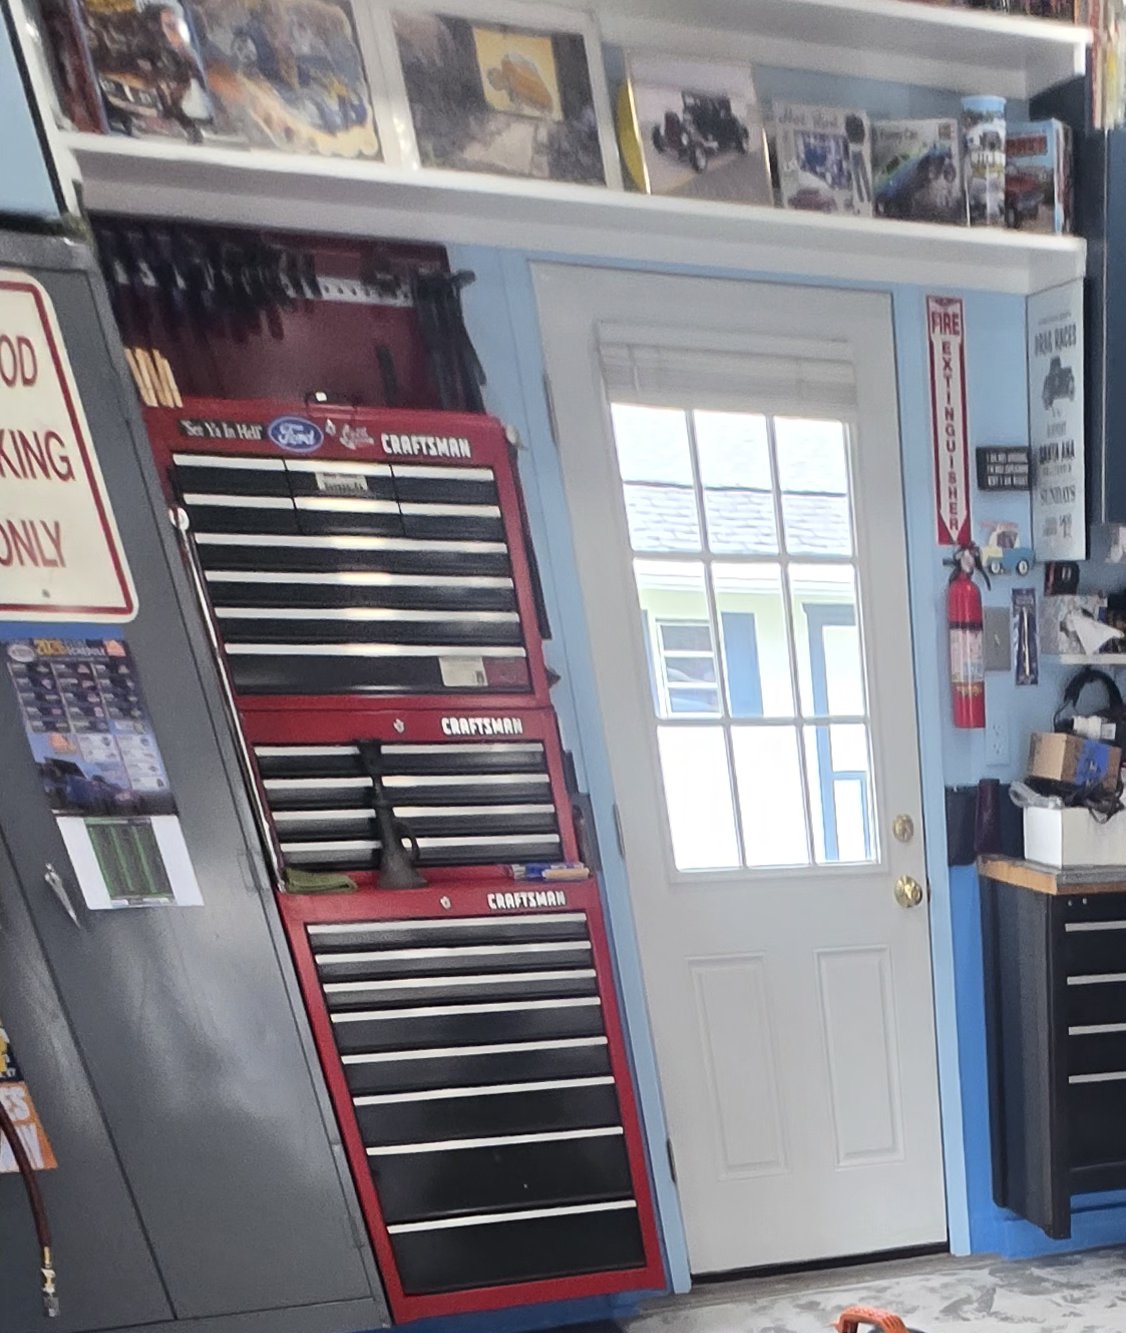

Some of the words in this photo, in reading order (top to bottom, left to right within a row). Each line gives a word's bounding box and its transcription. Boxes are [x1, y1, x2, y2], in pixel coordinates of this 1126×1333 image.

[931, 310, 960, 336] FIRE
[381, 433, 471, 458] CRAFTSMAN
[942, 341, 960, 531] EXTINGUISHER
[441, 717, 523, 735] CRAFTSMAN
[487, 891, 566, 909] CRAFTSMAN
